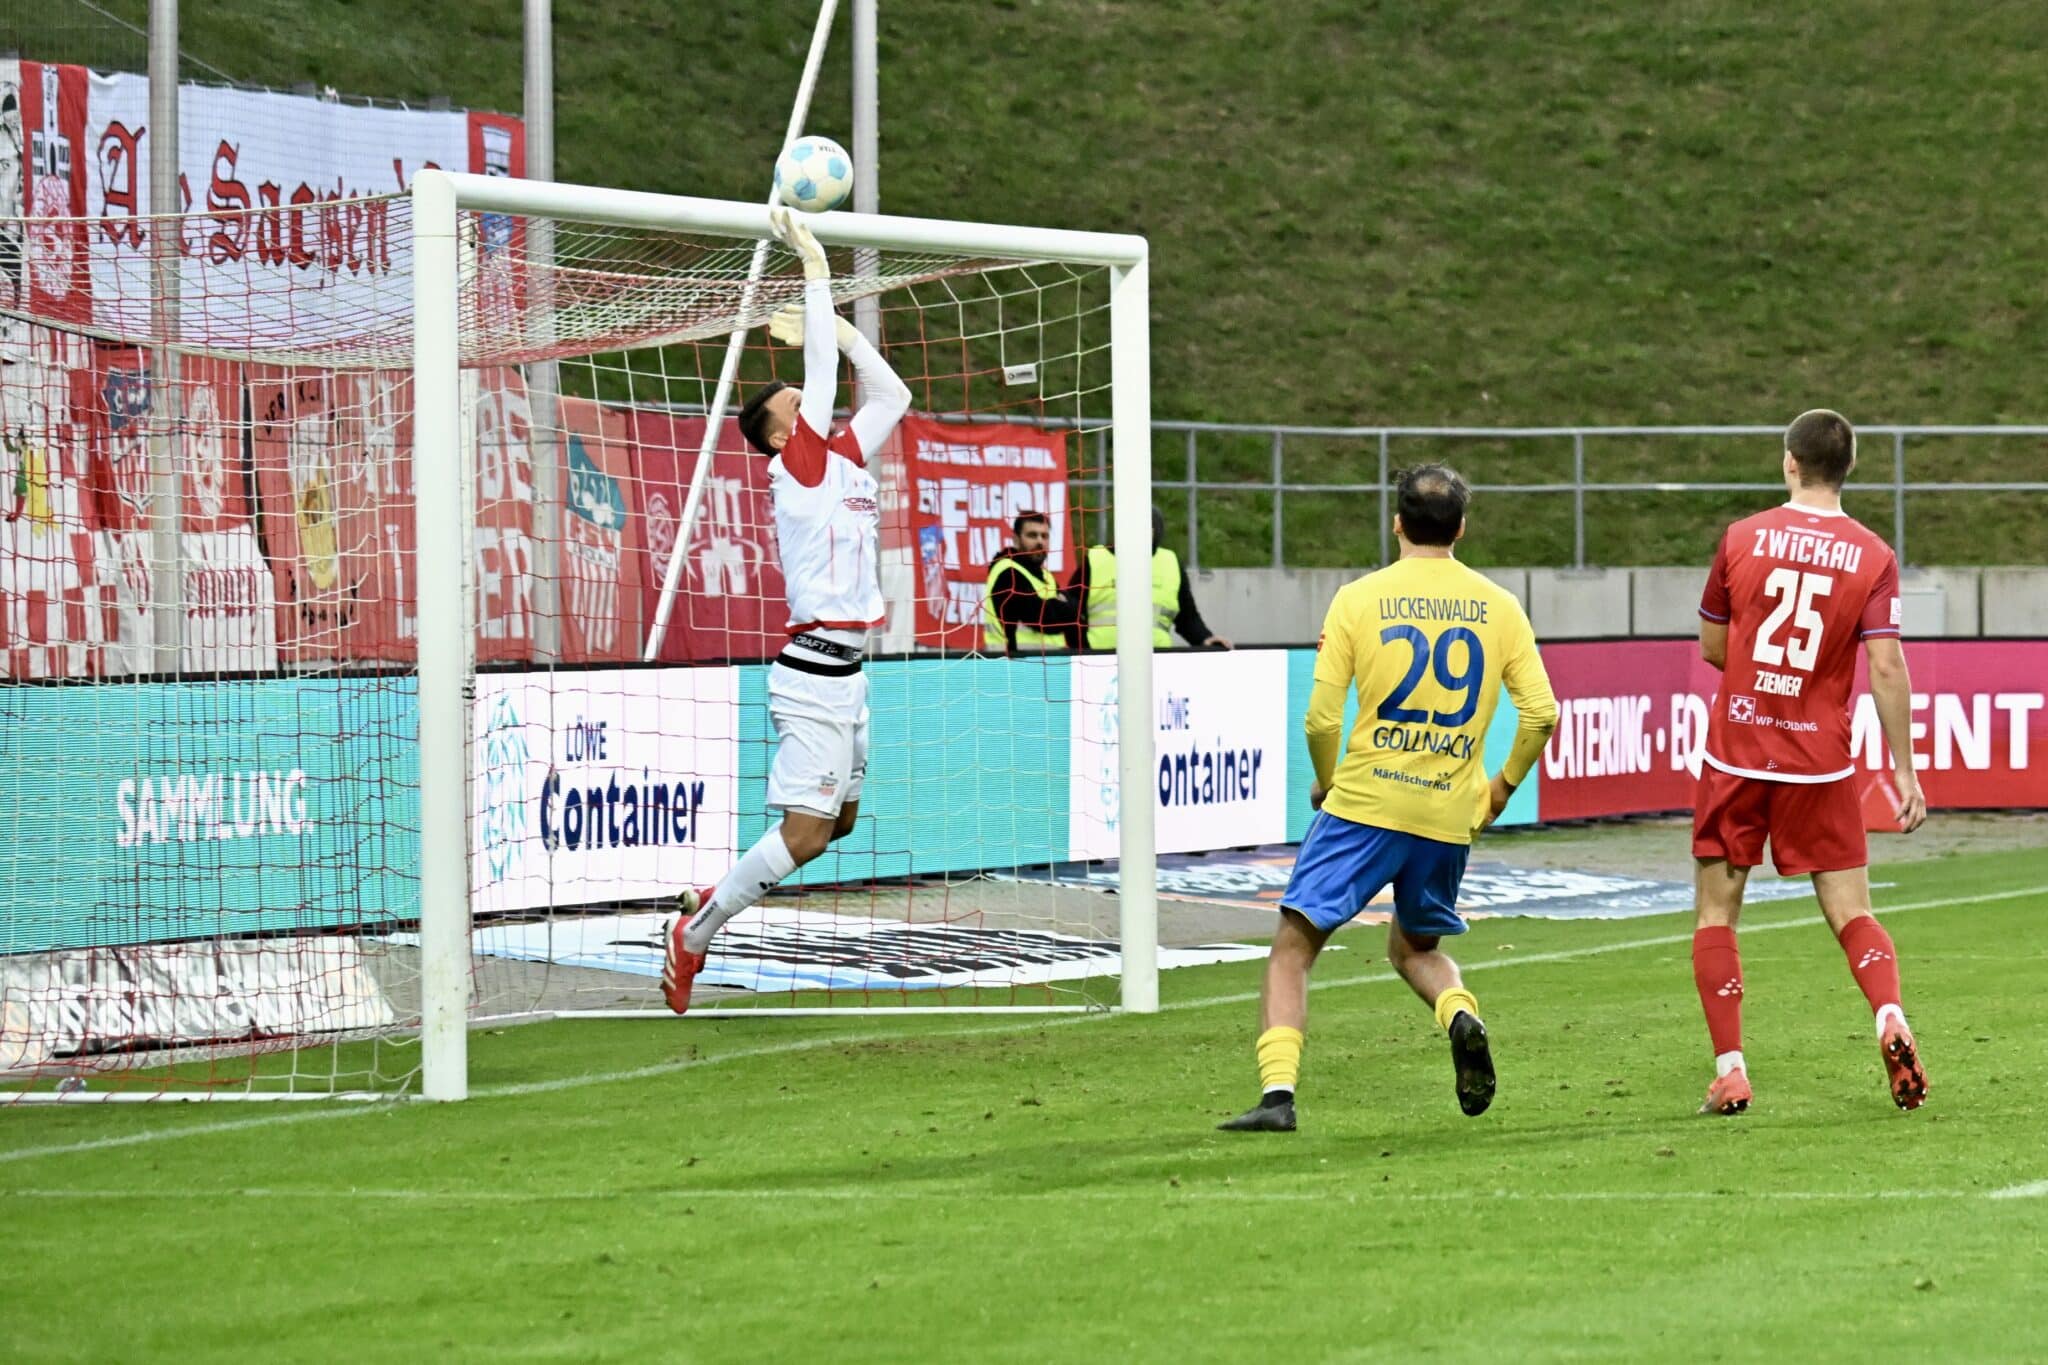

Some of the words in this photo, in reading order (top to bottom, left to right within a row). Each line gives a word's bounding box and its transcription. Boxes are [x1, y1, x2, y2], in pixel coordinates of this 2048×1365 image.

[1379, 597, 1487, 624] LUCKENWALDE
[1752, 567, 1833, 672] 25
[1377, 624, 1485, 728] 29
[566, 714, 607, 762] LÖWE
[1373, 726, 1475, 760] GOLLNACK
[1755, 715, 1773, 726] WP
[1775, 718, 1818, 732] HOLDING
[1159, 735, 1262, 807] ontainer
[540, 765, 705, 851] Container
